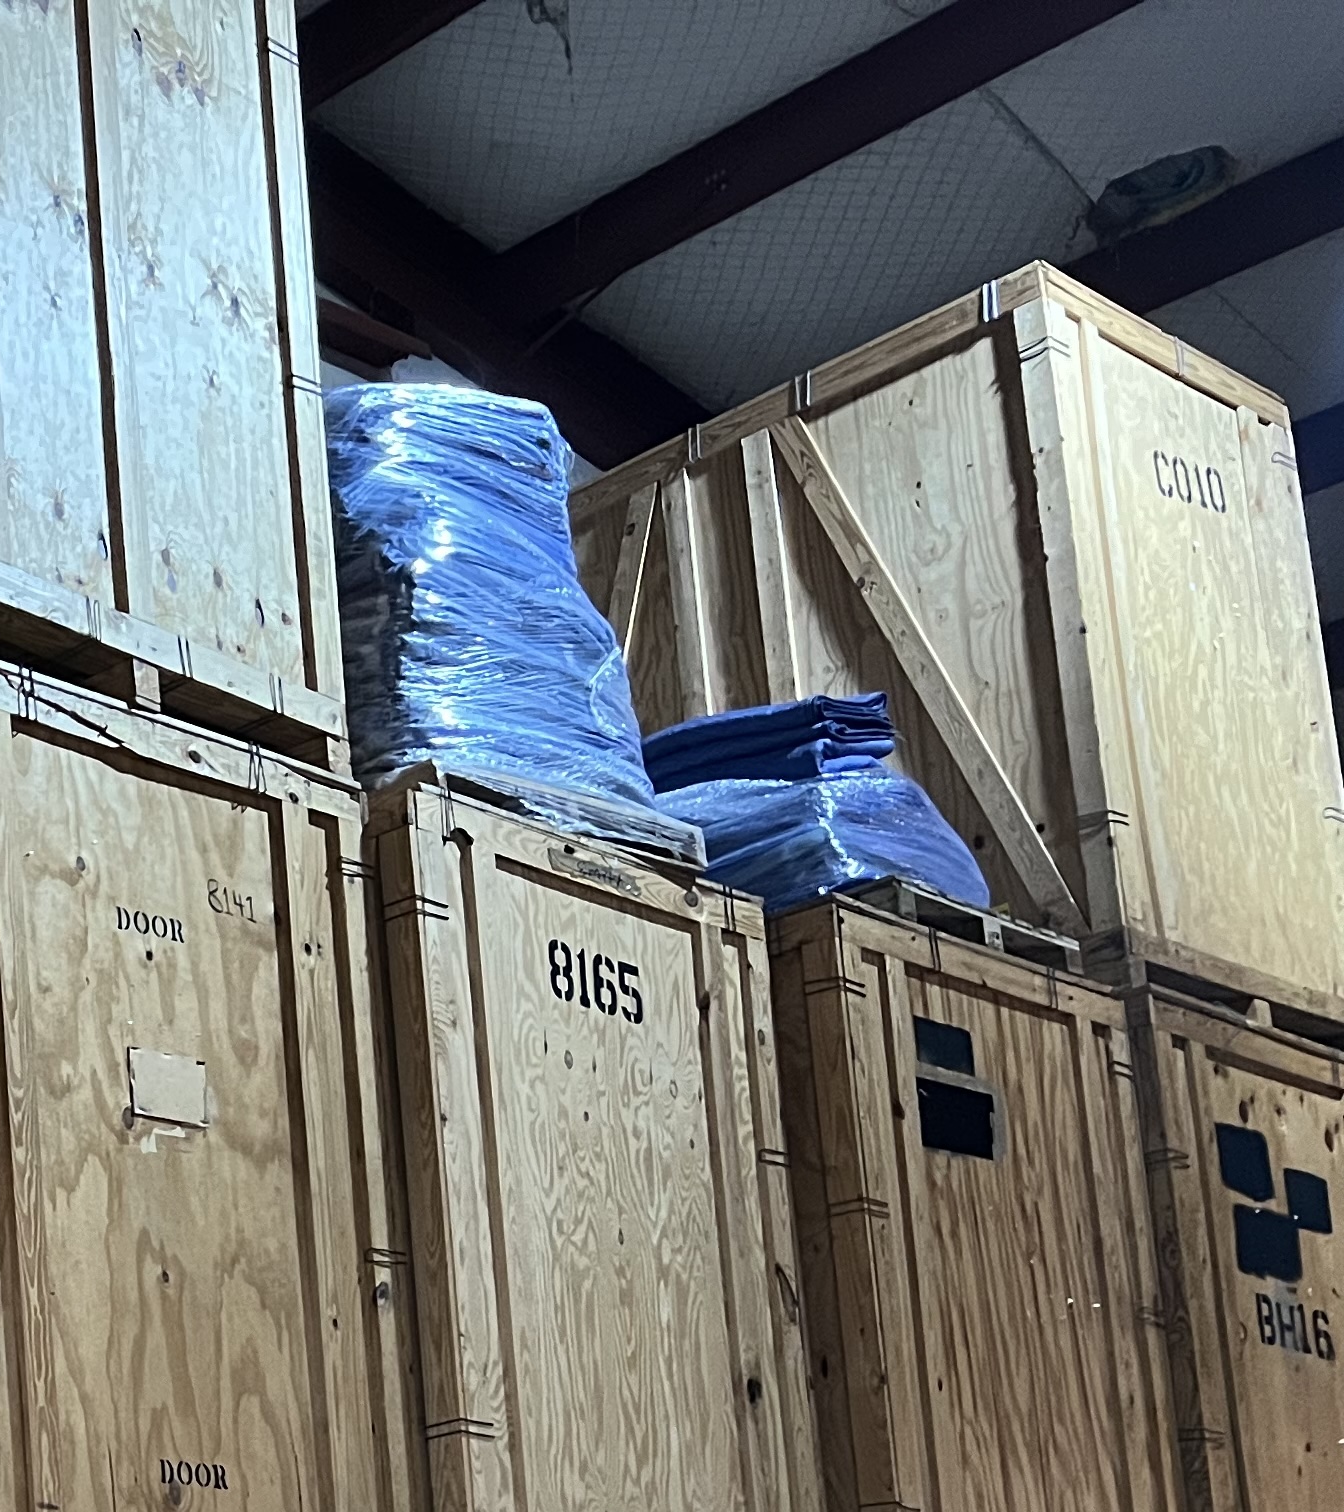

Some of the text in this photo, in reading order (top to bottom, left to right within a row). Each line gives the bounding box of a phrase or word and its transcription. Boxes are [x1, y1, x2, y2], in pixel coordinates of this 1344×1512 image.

[207, 878, 257, 923] 8141
[115, 905, 185, 943] DOOR
[548, 938, 644, 1024] 8165
[1255, 1292, 1336, 1361] BH16
[159, 1458, 229, 1490] DOOR
